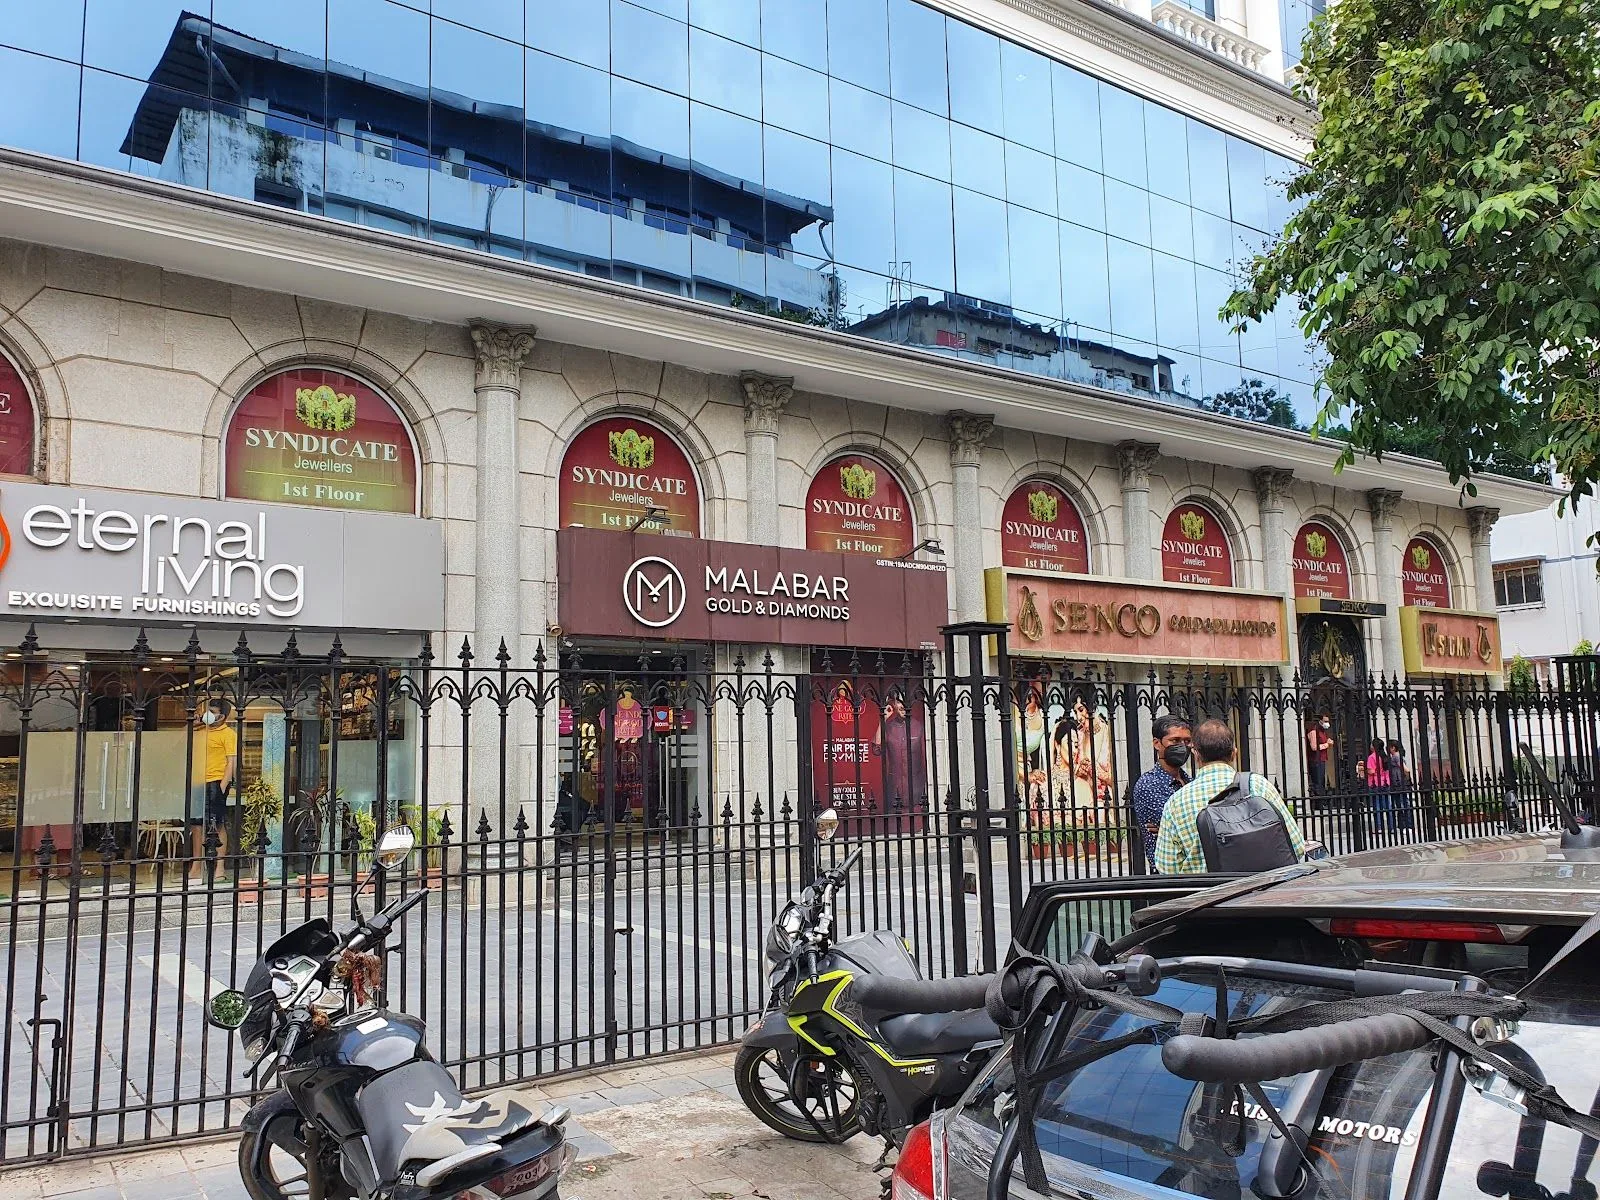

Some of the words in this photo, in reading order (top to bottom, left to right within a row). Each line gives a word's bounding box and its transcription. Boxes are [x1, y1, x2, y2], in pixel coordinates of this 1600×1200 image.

[245, 427, 398, 462] SYNDICATE
[294, 455, 353, 474] Jewellers
[572, 465, 687, 495] SYNDICATE
[282, 481, 309, 497] 1st
[315, 484, 364, 502] Floor
[609, 489, 653, 505] Jewellers
[813, 498, 902, 522] SYNDICATE
[841, 518, 876, 532] Jewellers
[1006, 520, 1079, 543] SYNDICATE
[22, 497, 266, 582] eternal
[835, 538, 852, 550] 1st
[854, 540, 884, 553] Floor
[1029, 540, 1058, 552] Jewellers
[1162, 539, 1223, 558] SYNDICATE
[1024, 557, 1038, 568] 1st
[1040, 559, 1064, 571] Floor
[1182, 556, 1206, 567] Jewellers
[1292, 558, 1342, 574] SYNDICATE
[705, 565, 850, 601] MALABAR
[1179, 572, 1190, 582] 1st
[1191, 573, 1211, 585] Floor
[1401, 570, 1444, 585] SYNDICATE
[1306, 588, 1315, 597] 1st
[8, 591, 123, 610] EXQUISITE
[132, 597, 261, 617] FURNISHINGS
[705, 597, 752, 614] GOLD
[755, 601, 766, 615] &
[769, 601, 850, 621] DIAMONDS
[1341, 600, 1369, 613] SENCO
[1051, 598, 1161, 638] SENCO
[844, 743, 869, 752] PRCE
[907, 1065, 936, 1077] HORNET
[1317, 1116, 1418, 1146] MOTORS
